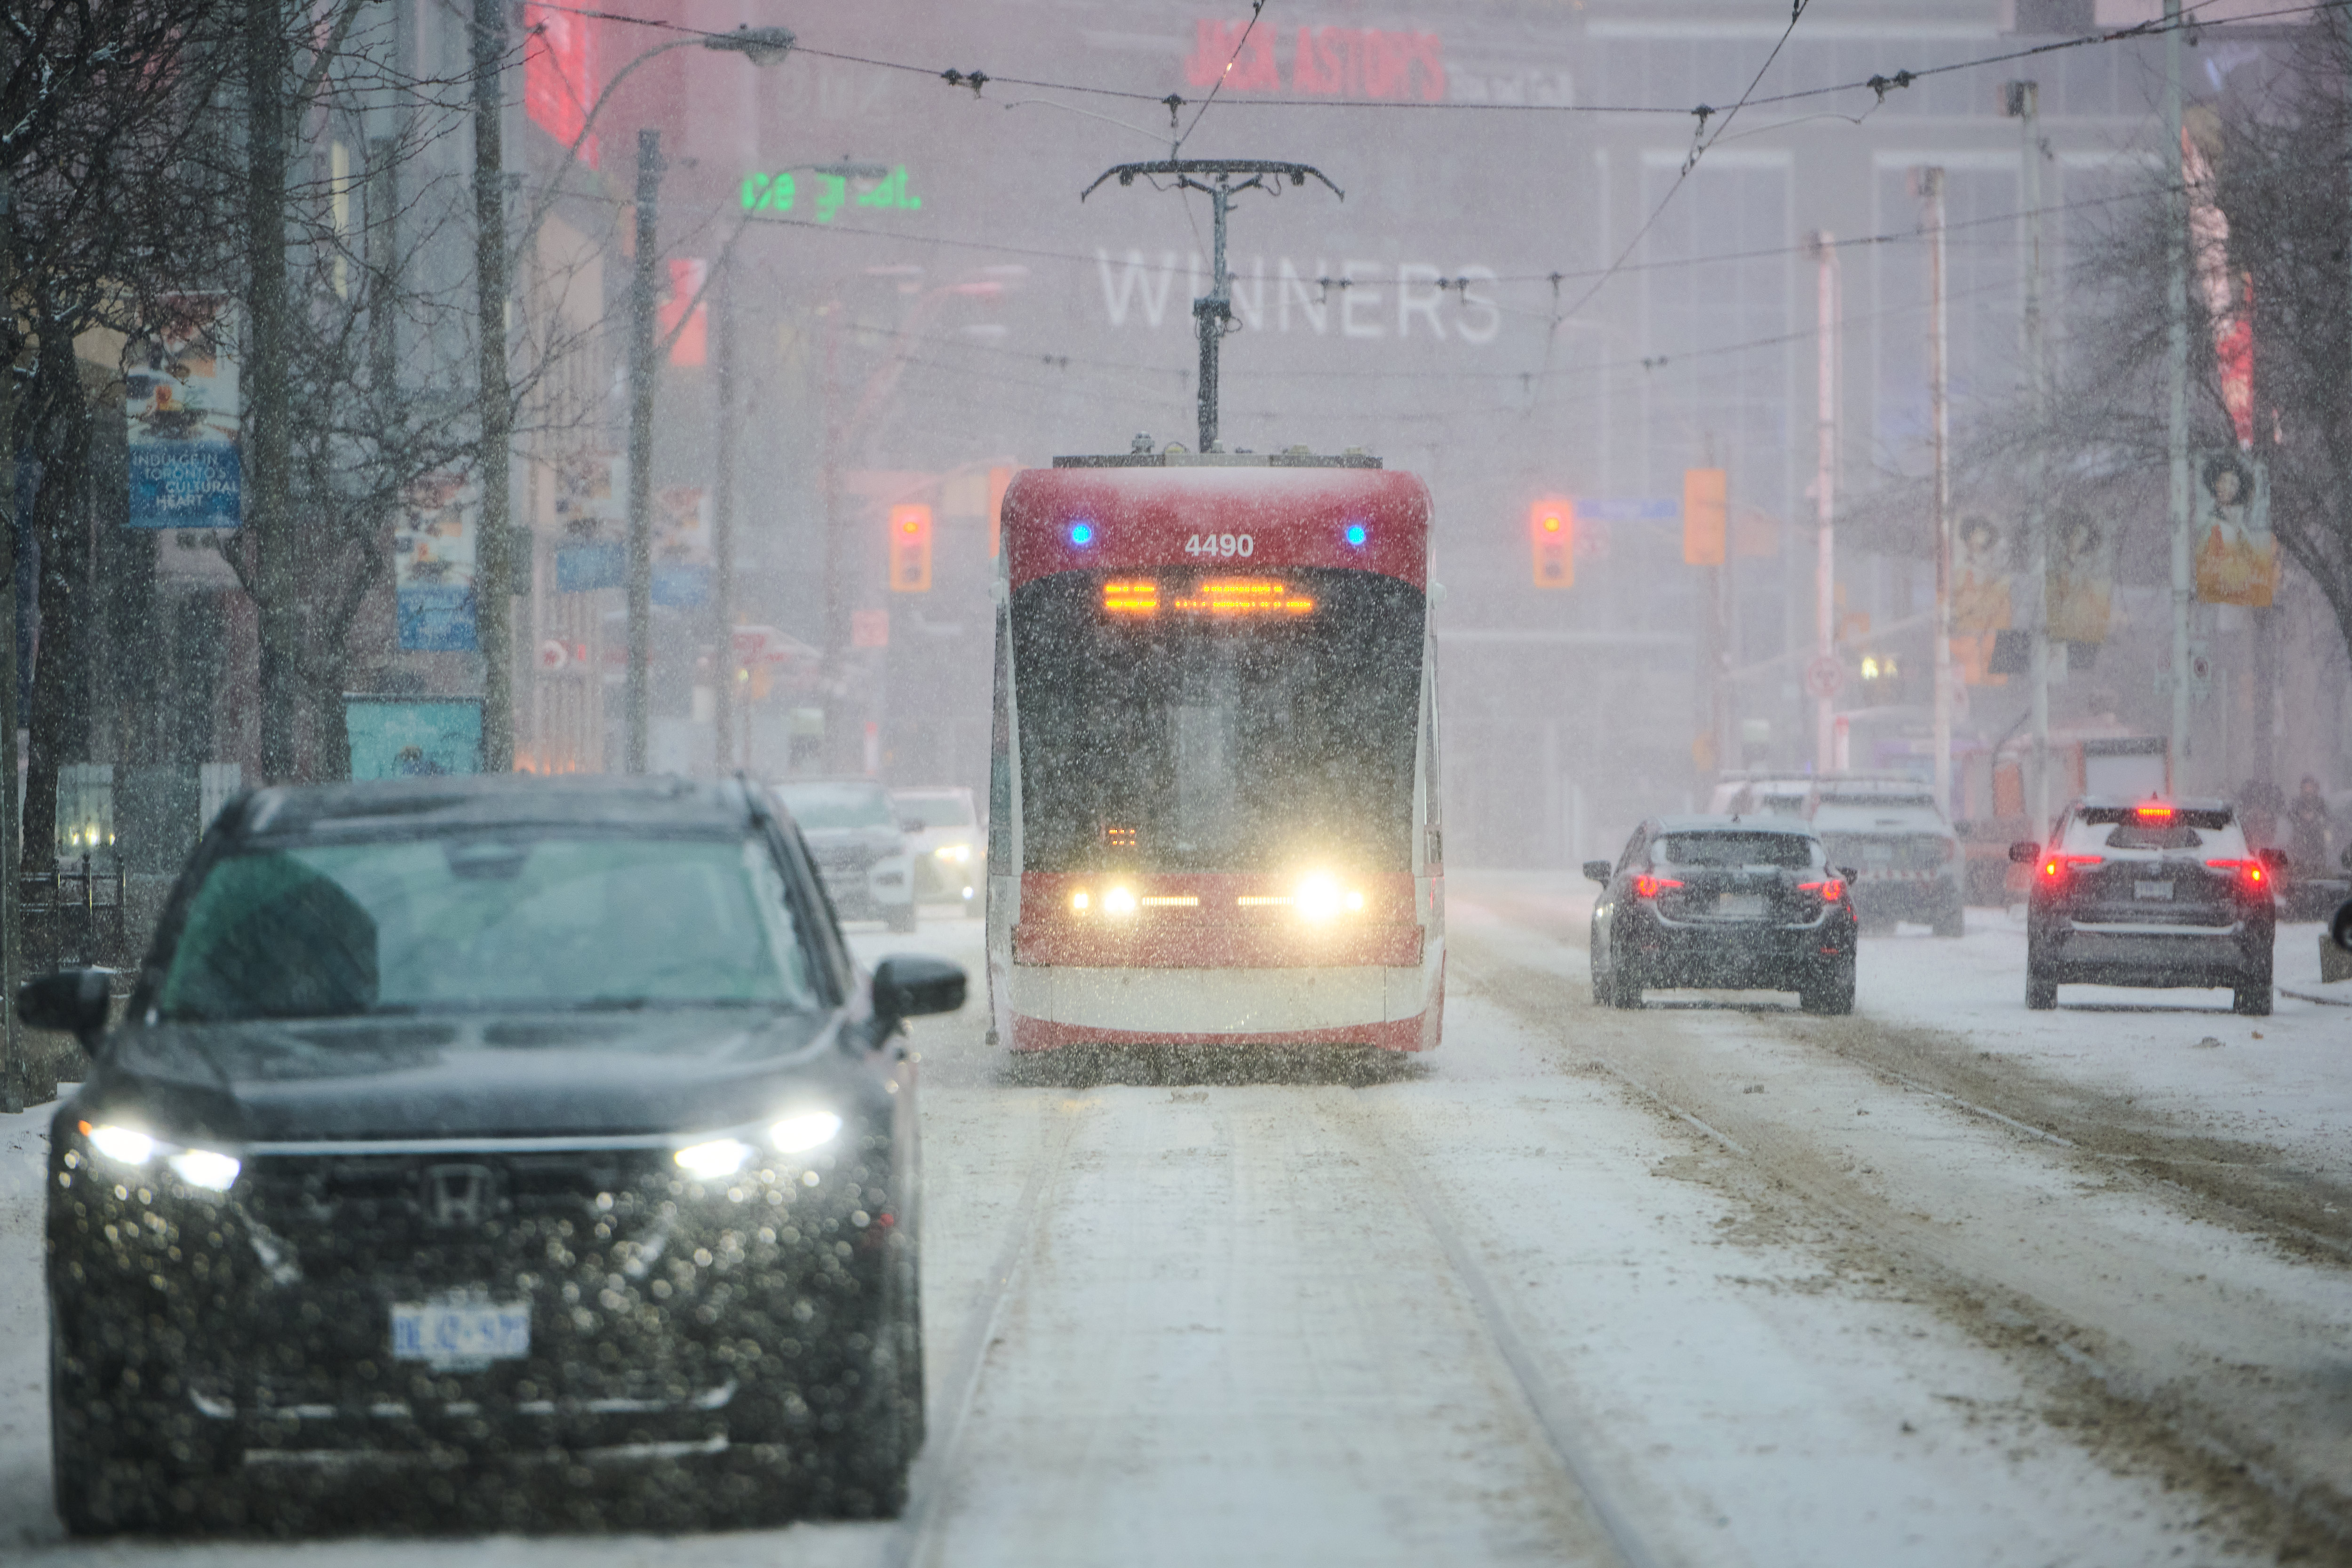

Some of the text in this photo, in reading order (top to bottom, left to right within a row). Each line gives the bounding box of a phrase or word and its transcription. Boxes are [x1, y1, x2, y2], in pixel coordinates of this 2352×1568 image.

[1097, 248, 1501, 344] WINNERS
[133, 453, 218, 467] INDULGE IN
[166, 481, 239, 493] CULTURAL
[156, 494, 204, 507] HEART
[1185, 533, 1254, 557] 4490
